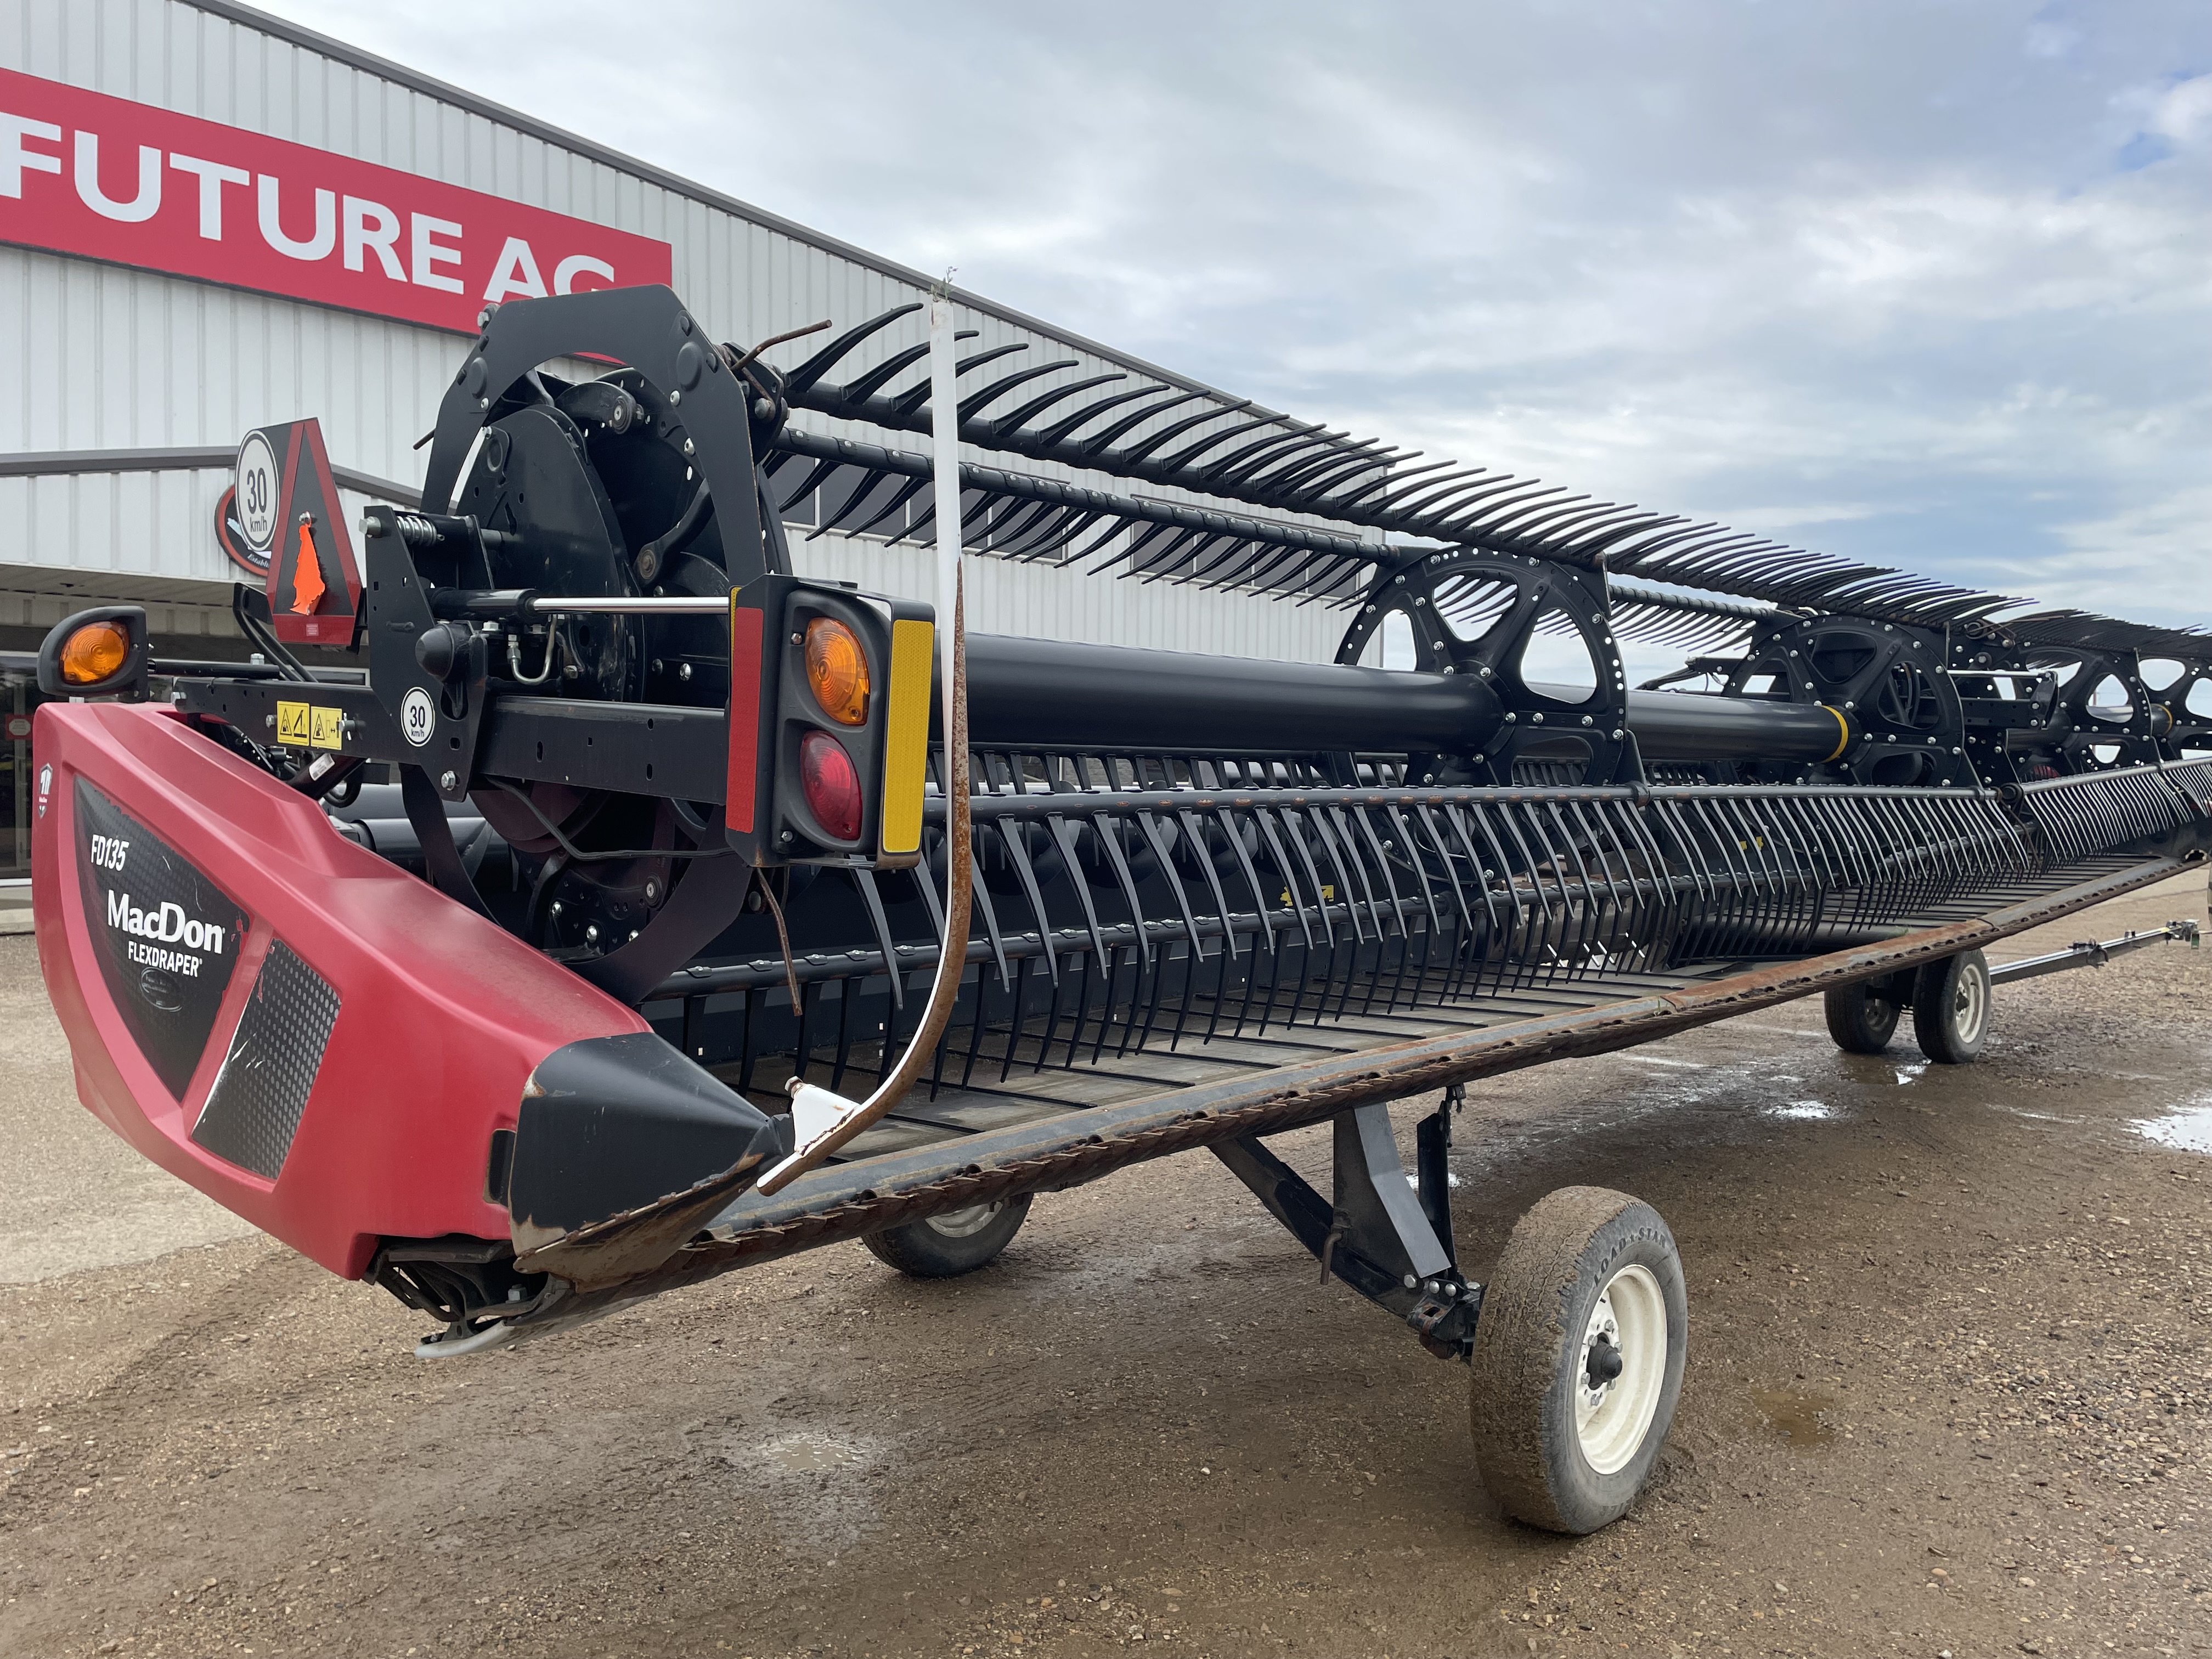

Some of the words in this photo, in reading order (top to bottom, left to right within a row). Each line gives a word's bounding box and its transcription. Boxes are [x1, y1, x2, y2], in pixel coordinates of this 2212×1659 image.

[0, 113, 465, 295] FUTURE
[483, 236, 614, 303] AG
[247, 467, 267, 515] 30
[250, 516, 267, 532] km/h
[410, 706, 425, 728] 30
[411, 729, 425, 737] km/h
[91, 834, 129, 871] FD135
[108, 889, 223, 954] MacDon
[128, 941, 199, 978] FLEXDRAPER
[1594, 1237, 1627, 1287] LOAD
[1638, 1227, 1666, 1249] STAR
